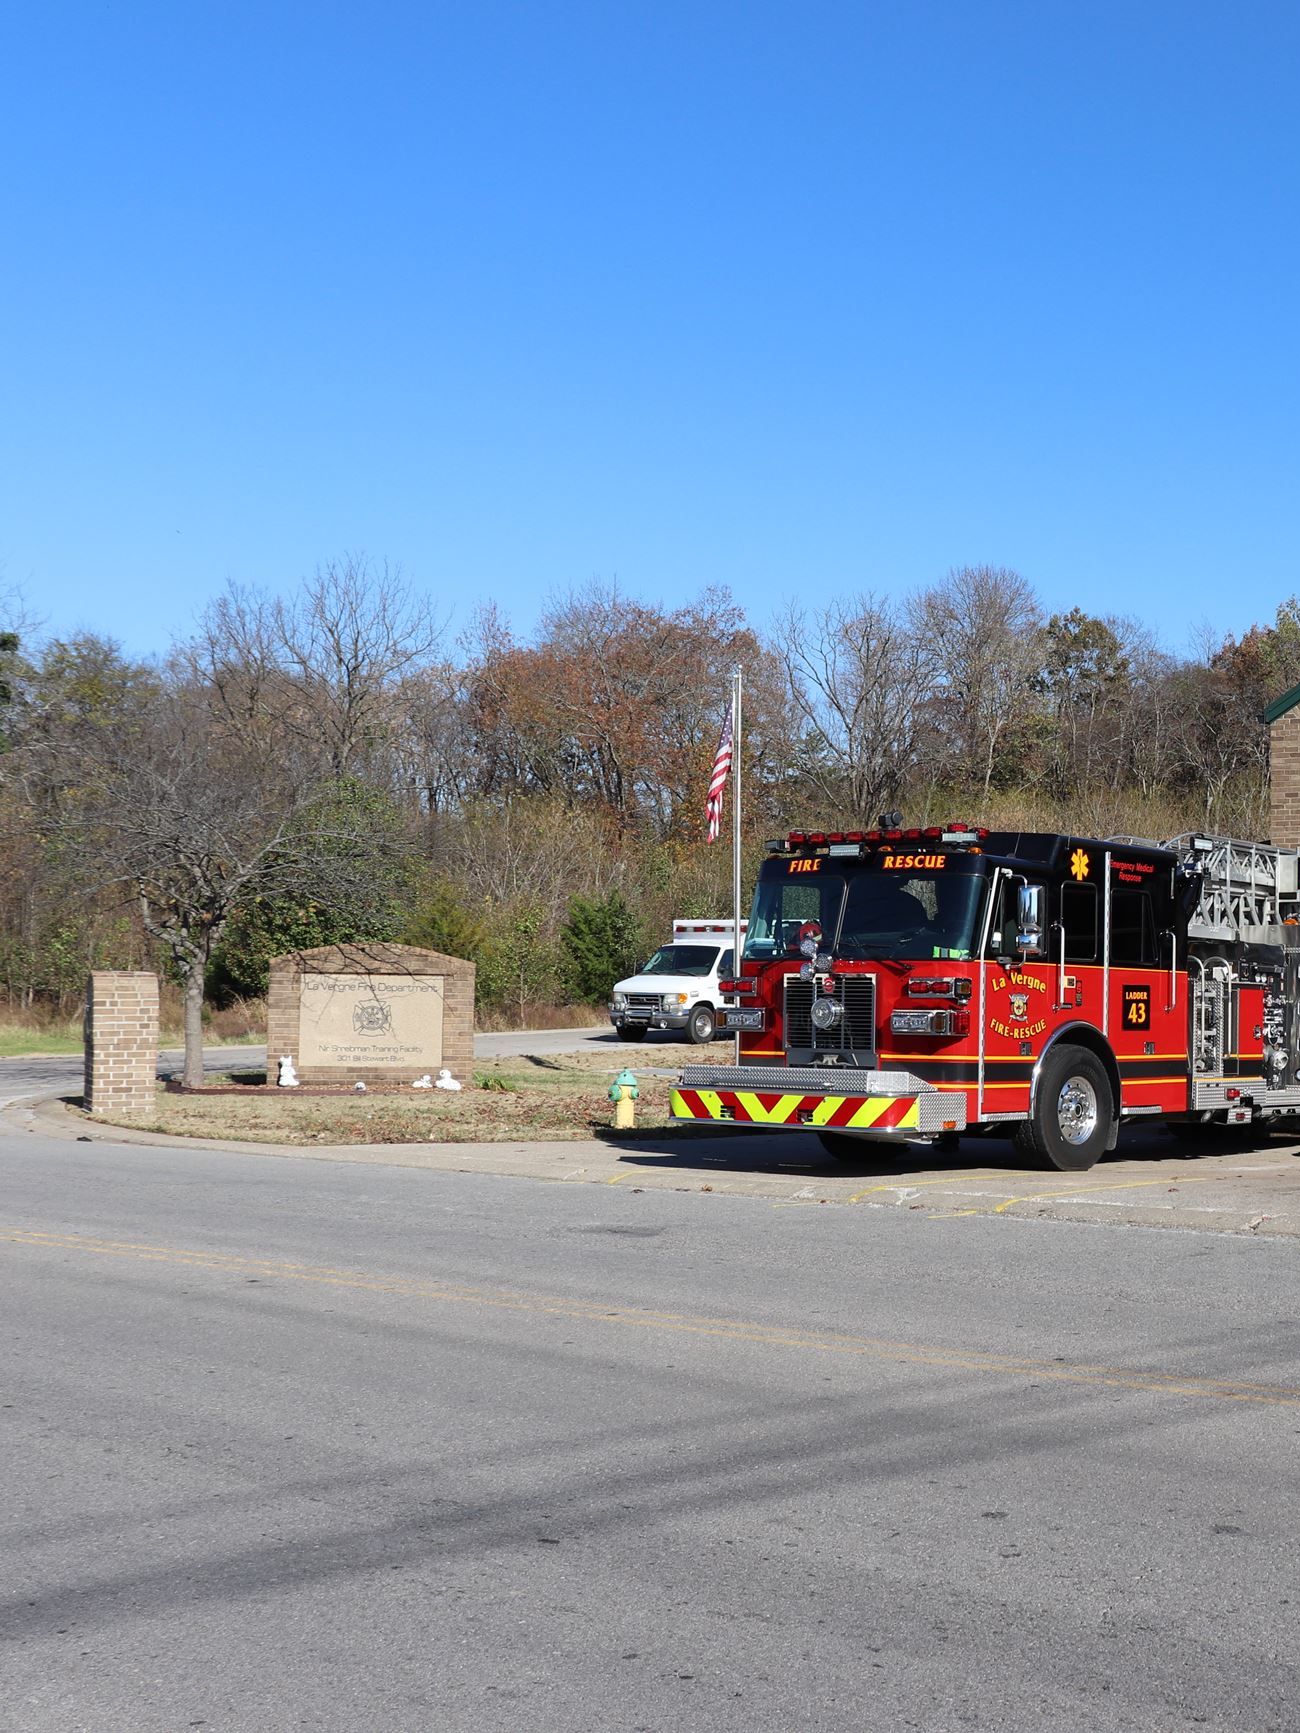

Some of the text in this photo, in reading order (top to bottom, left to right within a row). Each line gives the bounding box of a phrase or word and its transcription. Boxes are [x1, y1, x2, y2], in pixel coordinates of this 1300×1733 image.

[789, 858, 822, 873] FIRE
[883, 855, 946, 869] RESCUE
[1136, 863, 1154, 873] Medical
[1119, 871, 1142, 882] Response
[307, 982, 437, 992] La Vergne Fire Department
[992, 972, 1046, 993] La Vergne
[1125, 991, 1148, 1000] LADDER
[1128, 1002, 1146, 1023] 43
[990, 1018, 1047, 1039] FIRE-RESCUE
